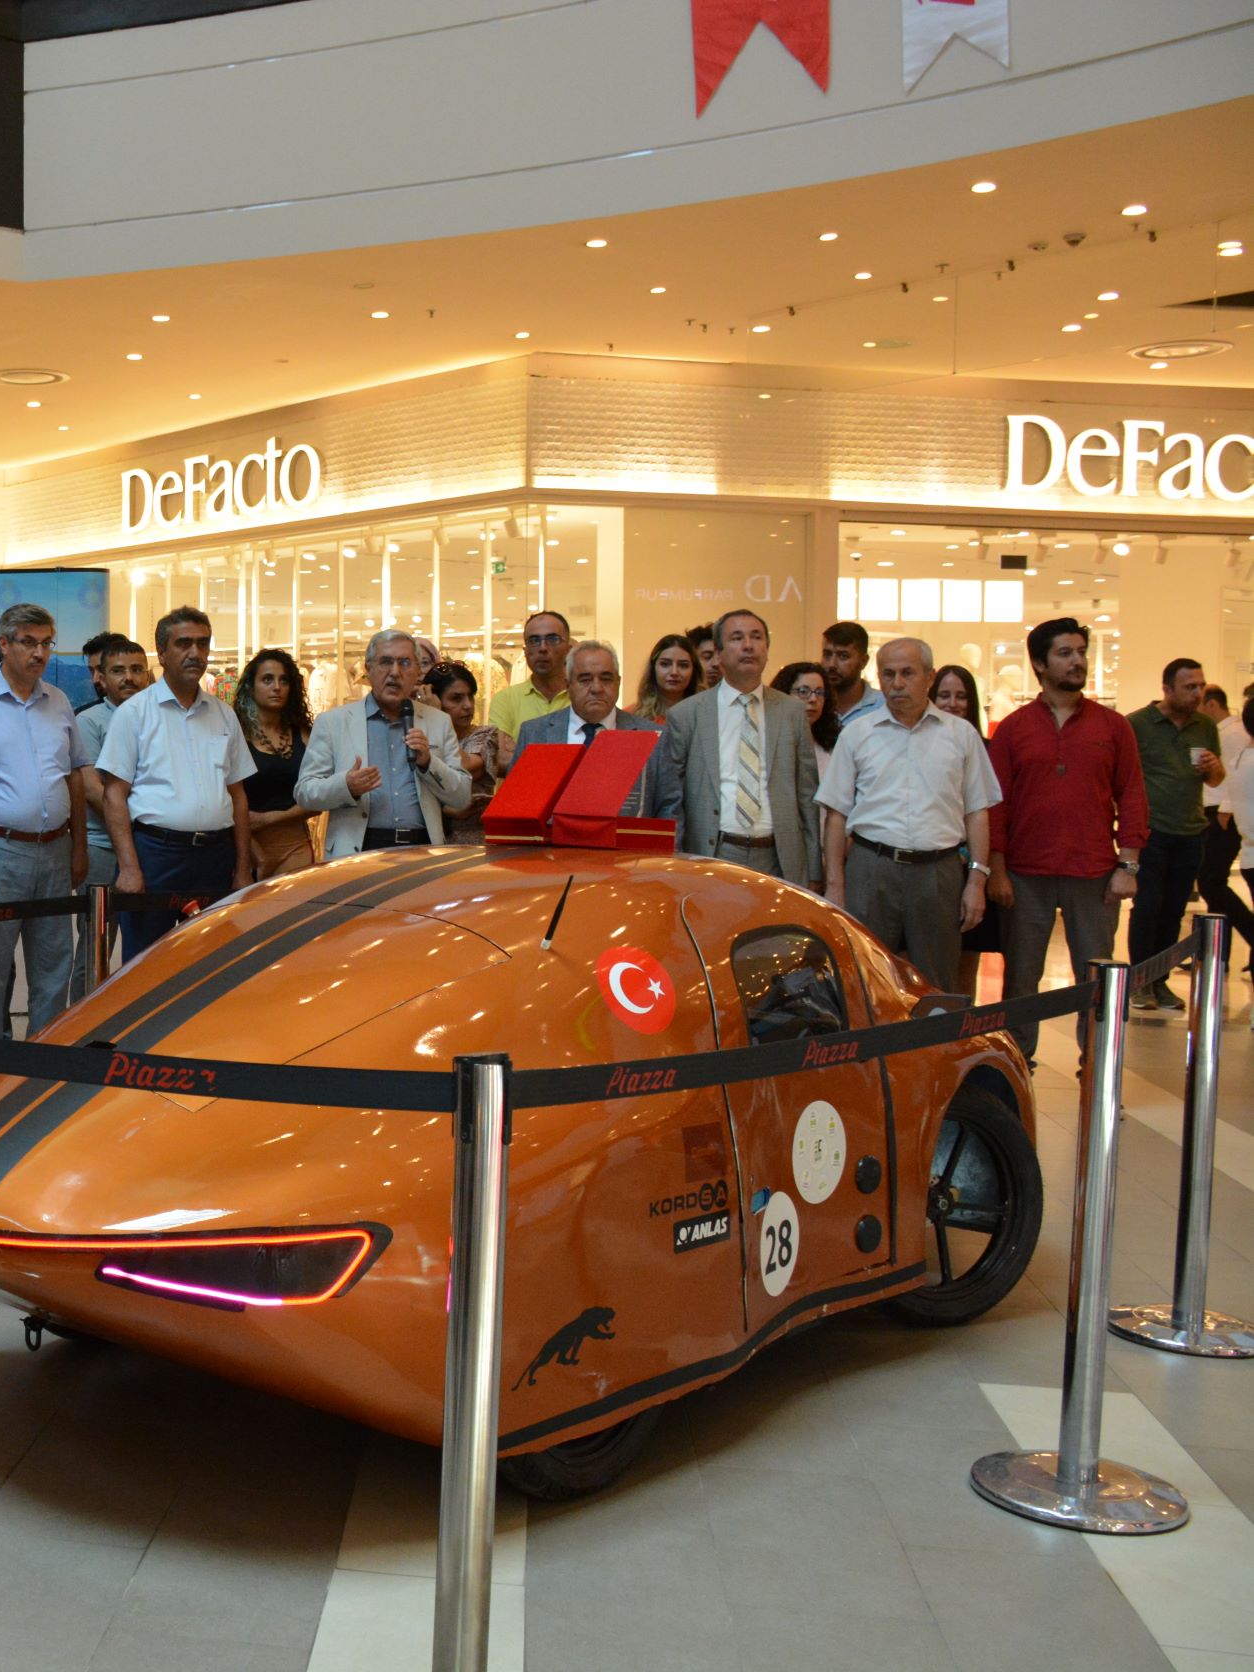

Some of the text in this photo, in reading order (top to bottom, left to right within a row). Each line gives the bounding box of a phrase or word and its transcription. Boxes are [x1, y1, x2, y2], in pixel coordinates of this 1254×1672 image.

[1004, 415, 1254, 501] DeFac
[121, 436, 321, 534] DeFacto
[959, 1010, 1006, 1038] Piazza
[802, 1039, 859, 1068] Piazza
[606, 1066, 678, 1096] Piazza
[649, 1180, 729, 1218] KORDSA
[765, 1219, 793, 1275] 28
